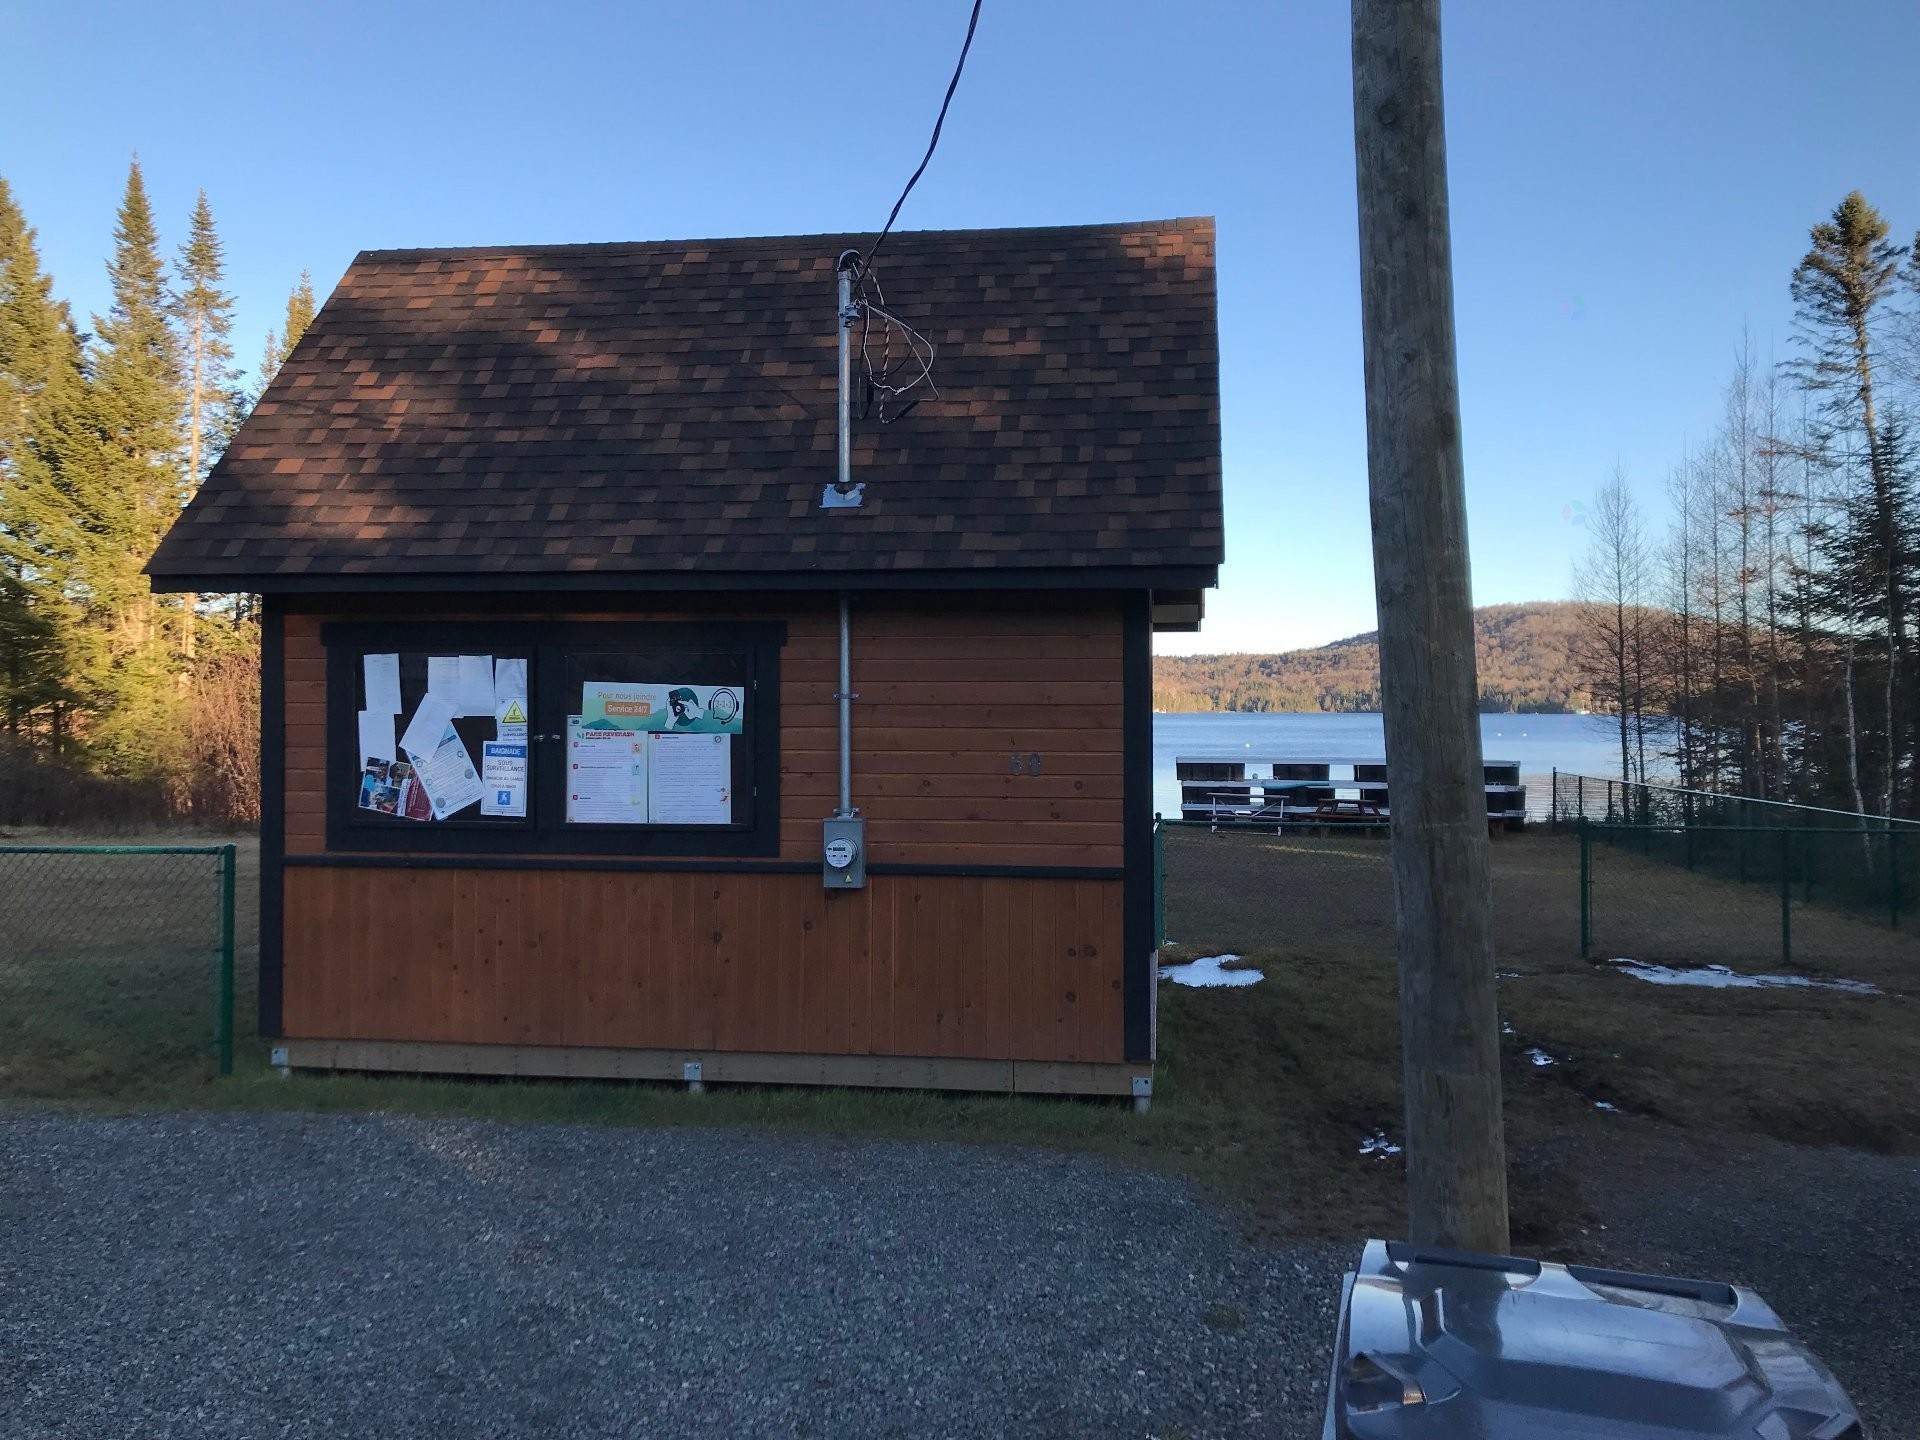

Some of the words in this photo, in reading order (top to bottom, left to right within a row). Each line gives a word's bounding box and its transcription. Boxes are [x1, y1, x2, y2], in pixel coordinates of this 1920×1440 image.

[598, 691, 613, 699] Pour
[633, 692, 657, 702] joindre
[607, 704, 633, 713] Service
[633, 705, 648, 714] 24/7
[490, 747, 521, 756] BAIGNADE
[486, 765, 525, 773] SURVEILLANCE
